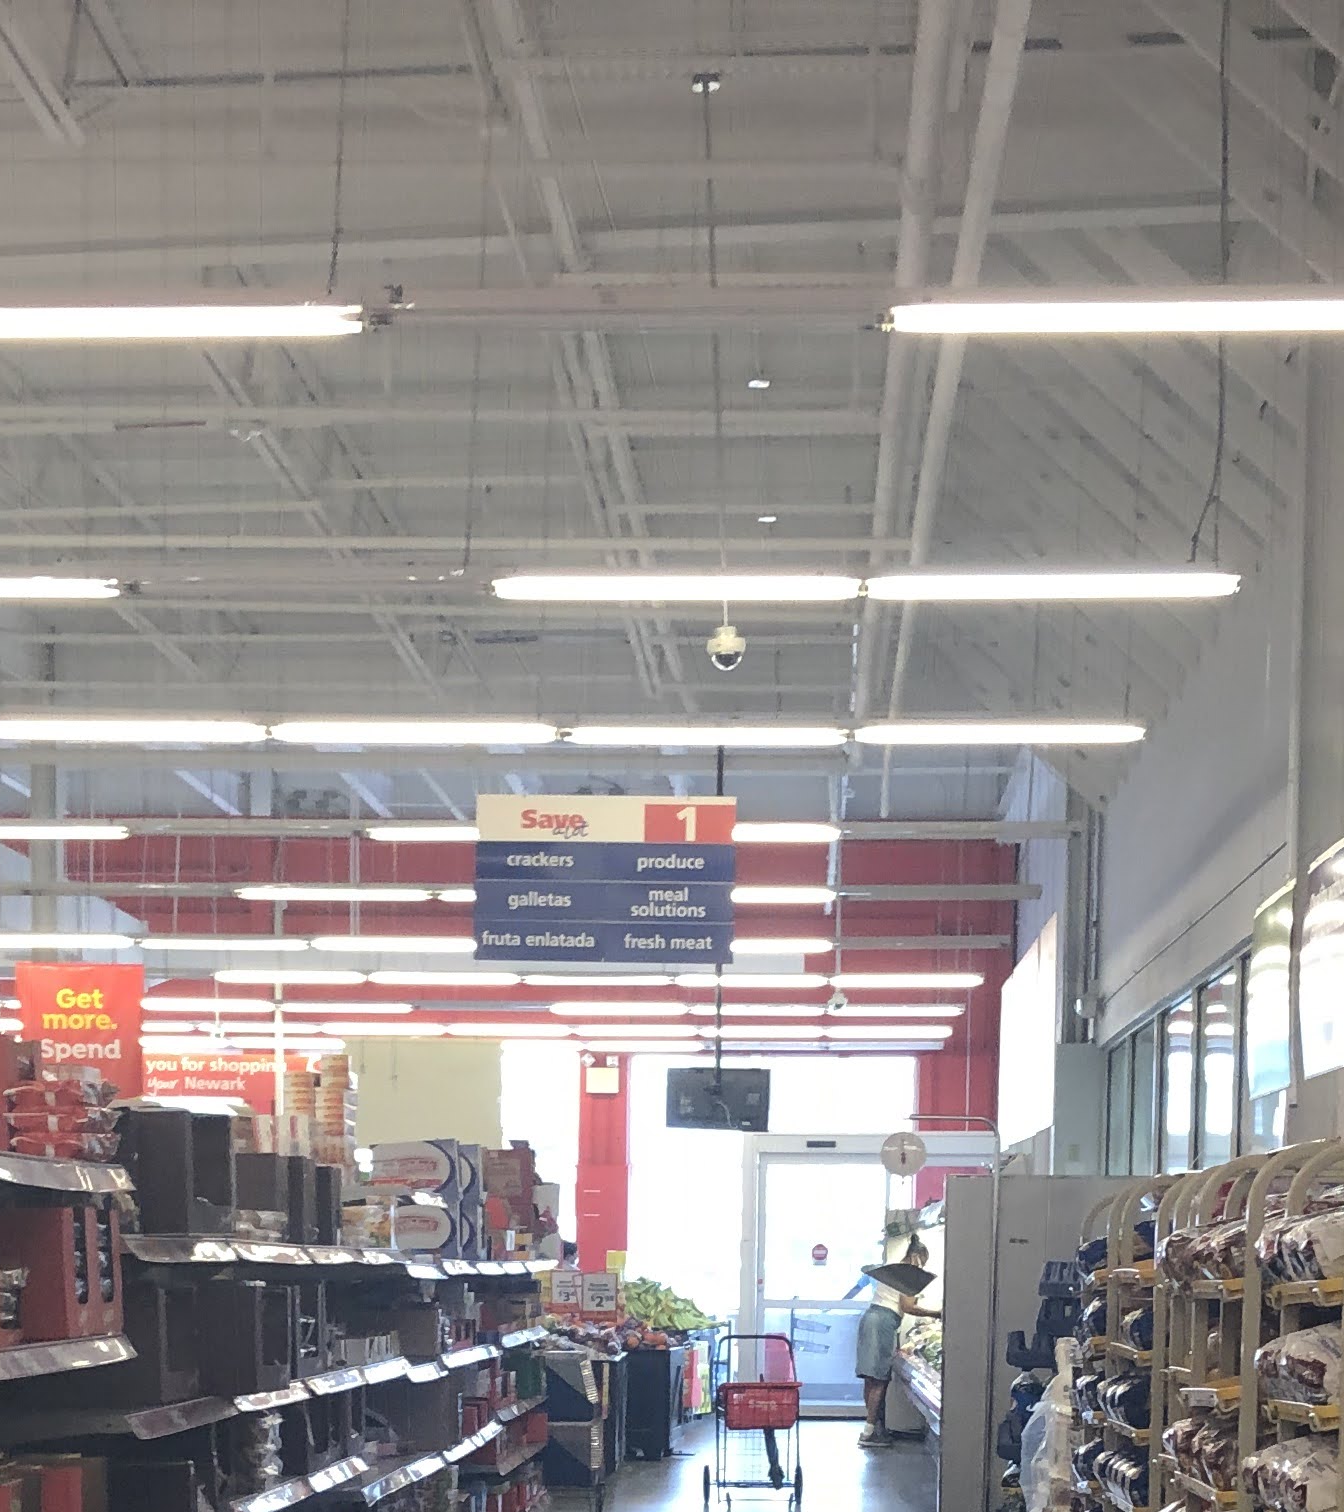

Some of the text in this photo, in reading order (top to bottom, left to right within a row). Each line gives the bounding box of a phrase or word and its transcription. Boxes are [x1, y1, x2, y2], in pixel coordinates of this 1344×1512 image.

[520, 809, 584, 829] Save
[676, 806, 698, 842] 1
[507, 851, 574, 867] crackers
[637, 854, 705, 872] produce
[508, 891, 571, 909] galletas
[648, 887, 689, 901] meal
[630, 902, 706, 918] solutions
[482, 931, 595, 948] fruta enlatada
[624, 934, 712, 950] fresh meat
[56, 988, 104, 1009] Get
[42, 1013, 118, 1031] more.
[40, 1038, 122, 1062] Spend
[145, 1058, 177, 1075] you
[181, 1056, 204, 1072] for
[184, 1077, 246, 1091] Newark
